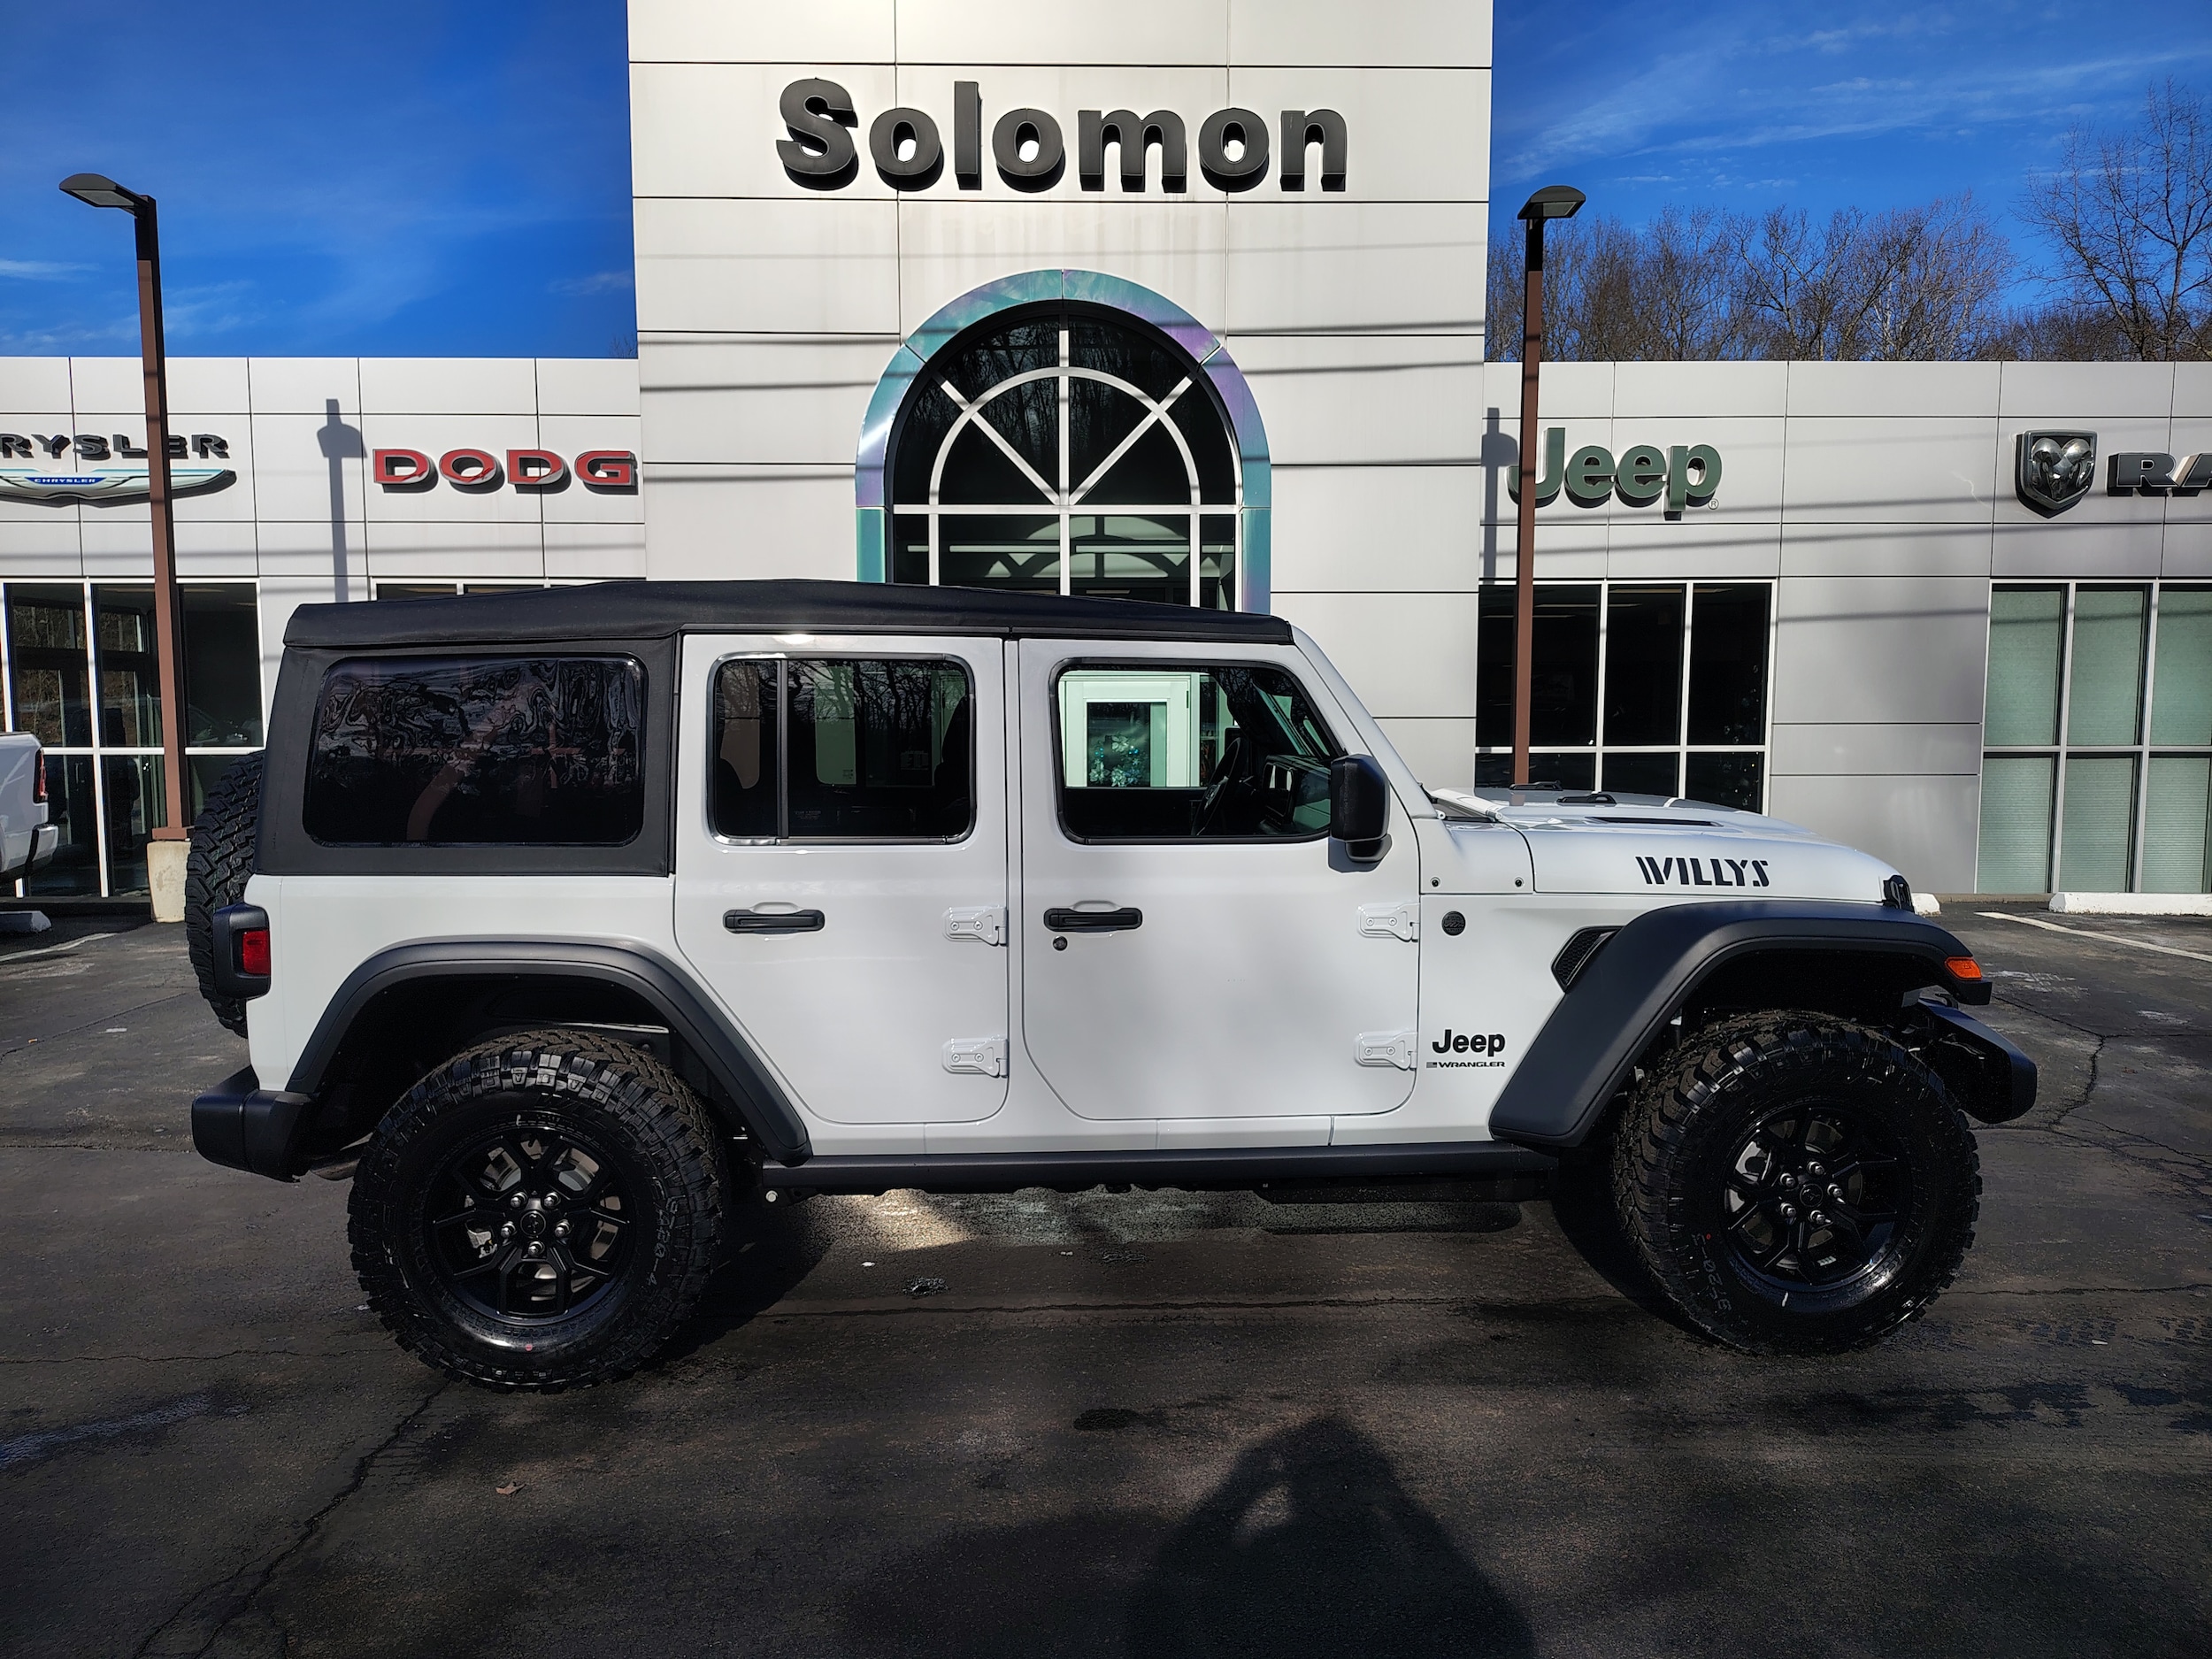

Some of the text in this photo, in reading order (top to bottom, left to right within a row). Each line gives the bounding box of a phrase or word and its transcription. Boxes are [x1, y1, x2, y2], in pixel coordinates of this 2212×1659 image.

[776, 78, 1347, 192] Solomon
[373, 449, 638, 494] DODG
[1507, 427, 1722, 520] Jeep
[1635, 856, 1770, 887] WILLYS
[1432, 1029, 1506, 1057] Jeep
